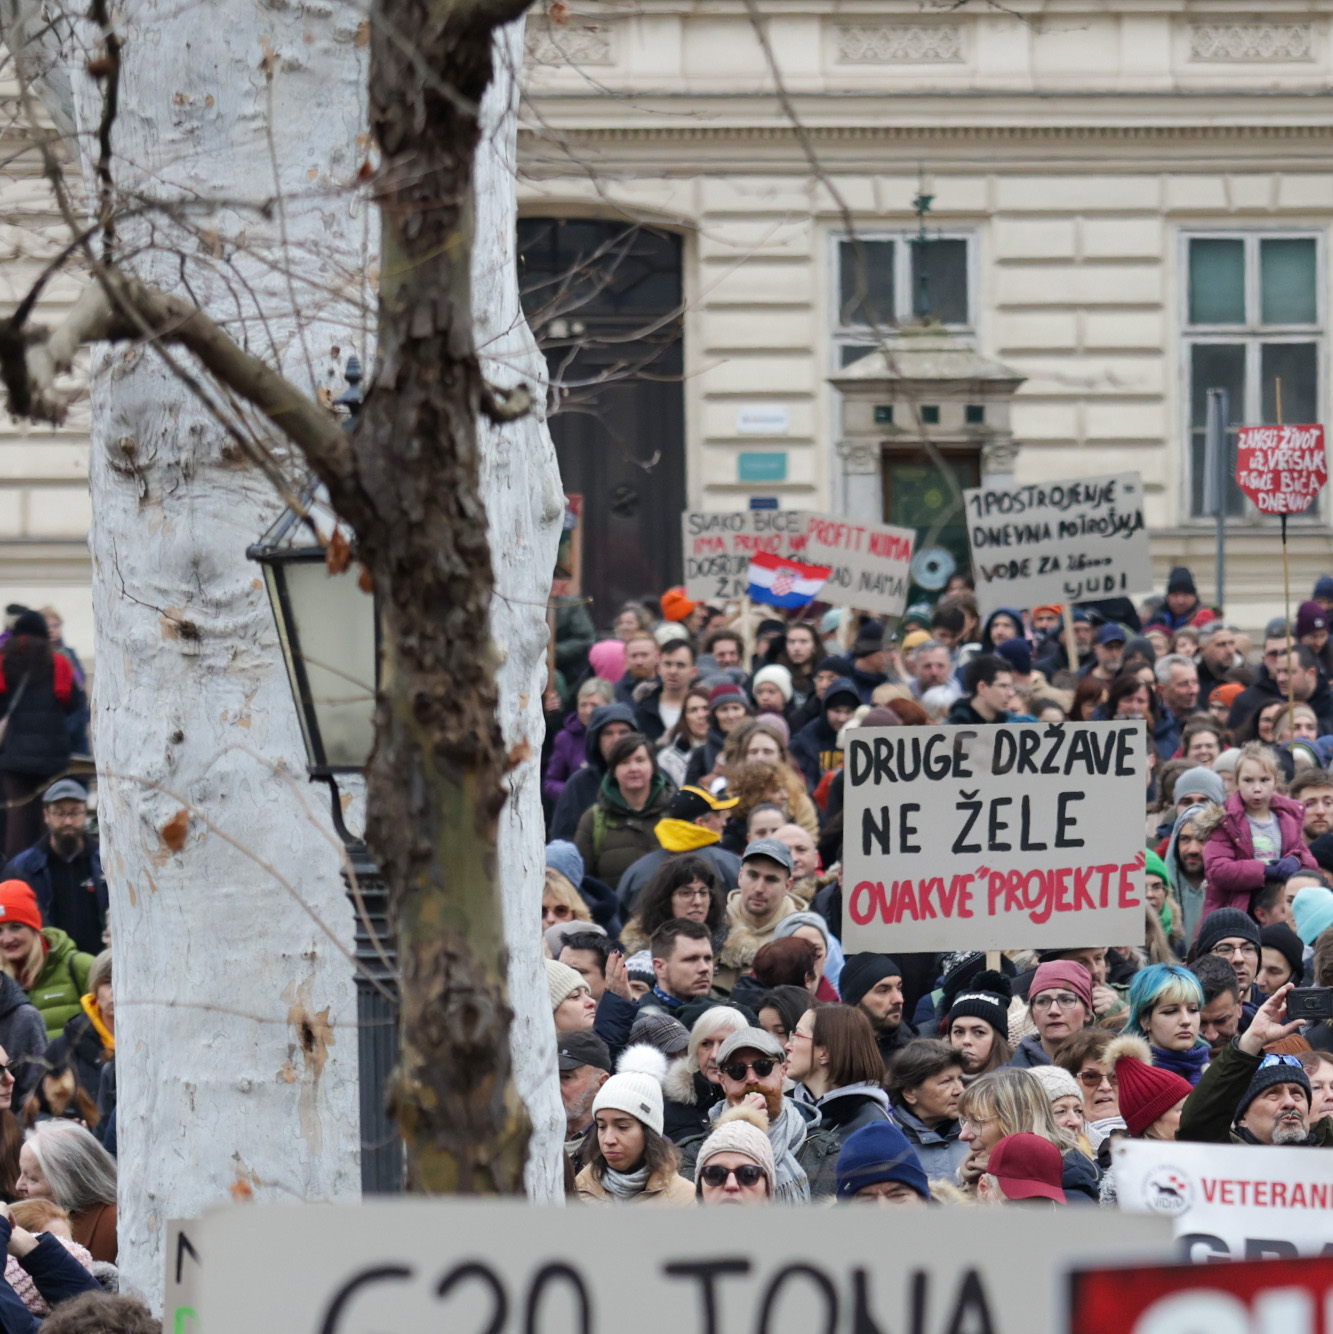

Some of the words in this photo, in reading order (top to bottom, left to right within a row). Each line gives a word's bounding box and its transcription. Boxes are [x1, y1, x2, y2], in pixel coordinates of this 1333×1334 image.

[688, 514, 743, 535] SVAKO
[808, 518, 866, 549] PROFIT
[973, 523, 1051, 548] DNEVNA
[980, 559, 1031, 583] VODE
[1037, 555, 1060, 574] ZA
[1064, 572, 1127, 599] LJUDI
[850, 731, 977, 786] DRUGE
[991, 723, 1138, 777] DRŽAVE
[862, 803, 921, 855] NE
[952, 789, 1085, 854] ŽELE
[849, 873, 974, 925] OVAKVE
